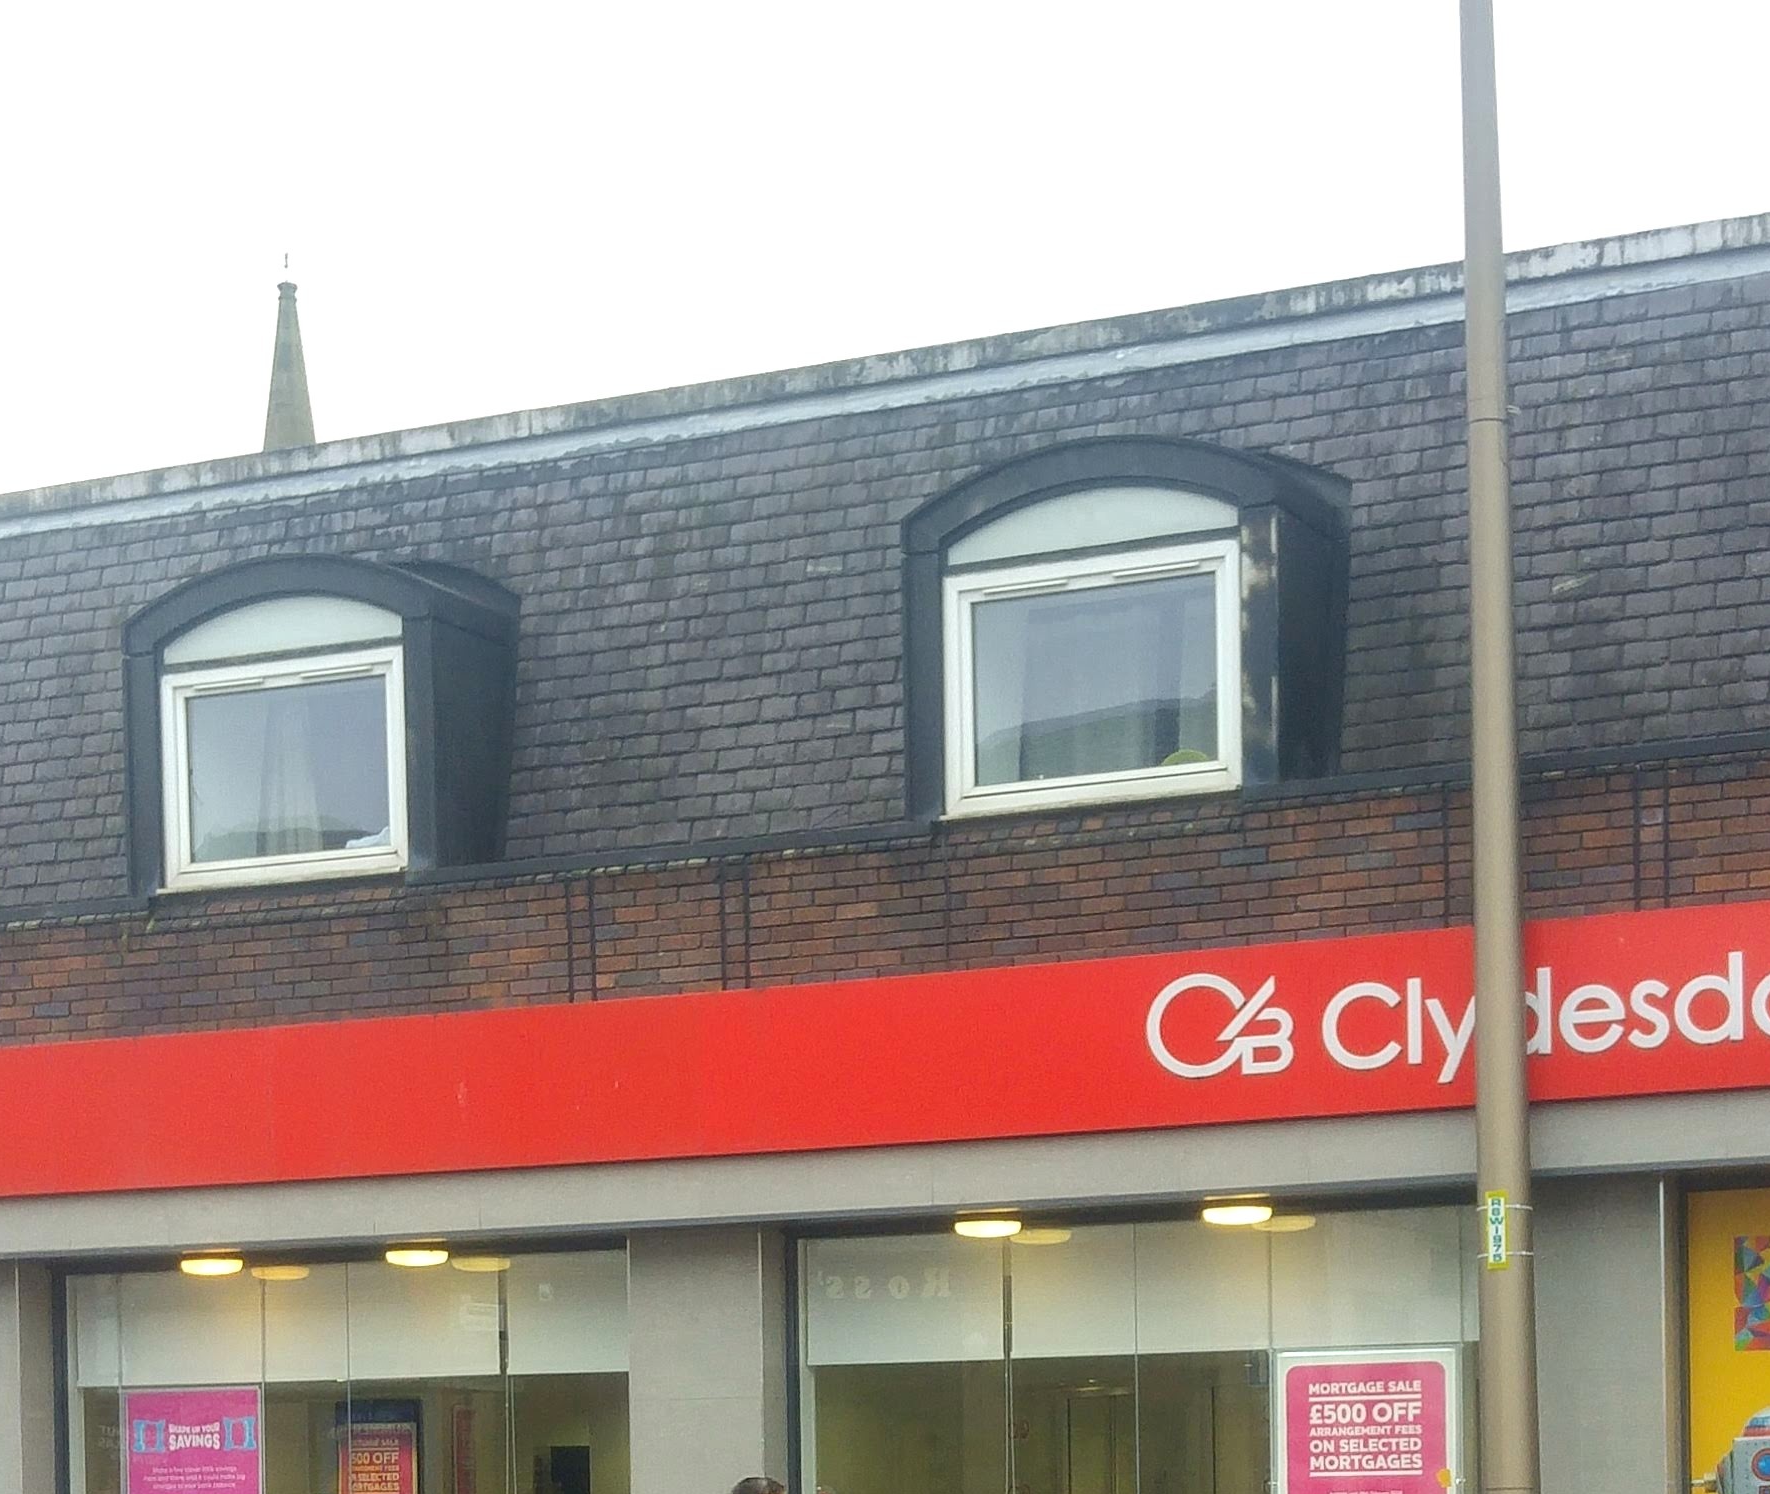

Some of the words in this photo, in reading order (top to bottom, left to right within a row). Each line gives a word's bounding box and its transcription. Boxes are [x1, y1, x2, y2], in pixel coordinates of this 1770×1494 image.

[1308, 1381, 1385, 1395] MORTGAGE
[1388, 1380, 1422, 1392] SALE
[1309, 1402, 1367, 1424] £500
[1372, 1402, 1422, 1423] OFF
[1309, 1425, 1391, 1437] ARRANGEMENT
[1394, 1425, 1422, 1435] FEES
[168, 1433, 221, 1452] SAVINGS
[1309, 1439, 1335, 1453] ON
[1339, 1438, 1422, 1452] SELECTED
[372, 1452, 400, 1463] OFF
[1309, 1454, 1423, 1471] MORTGAGES
